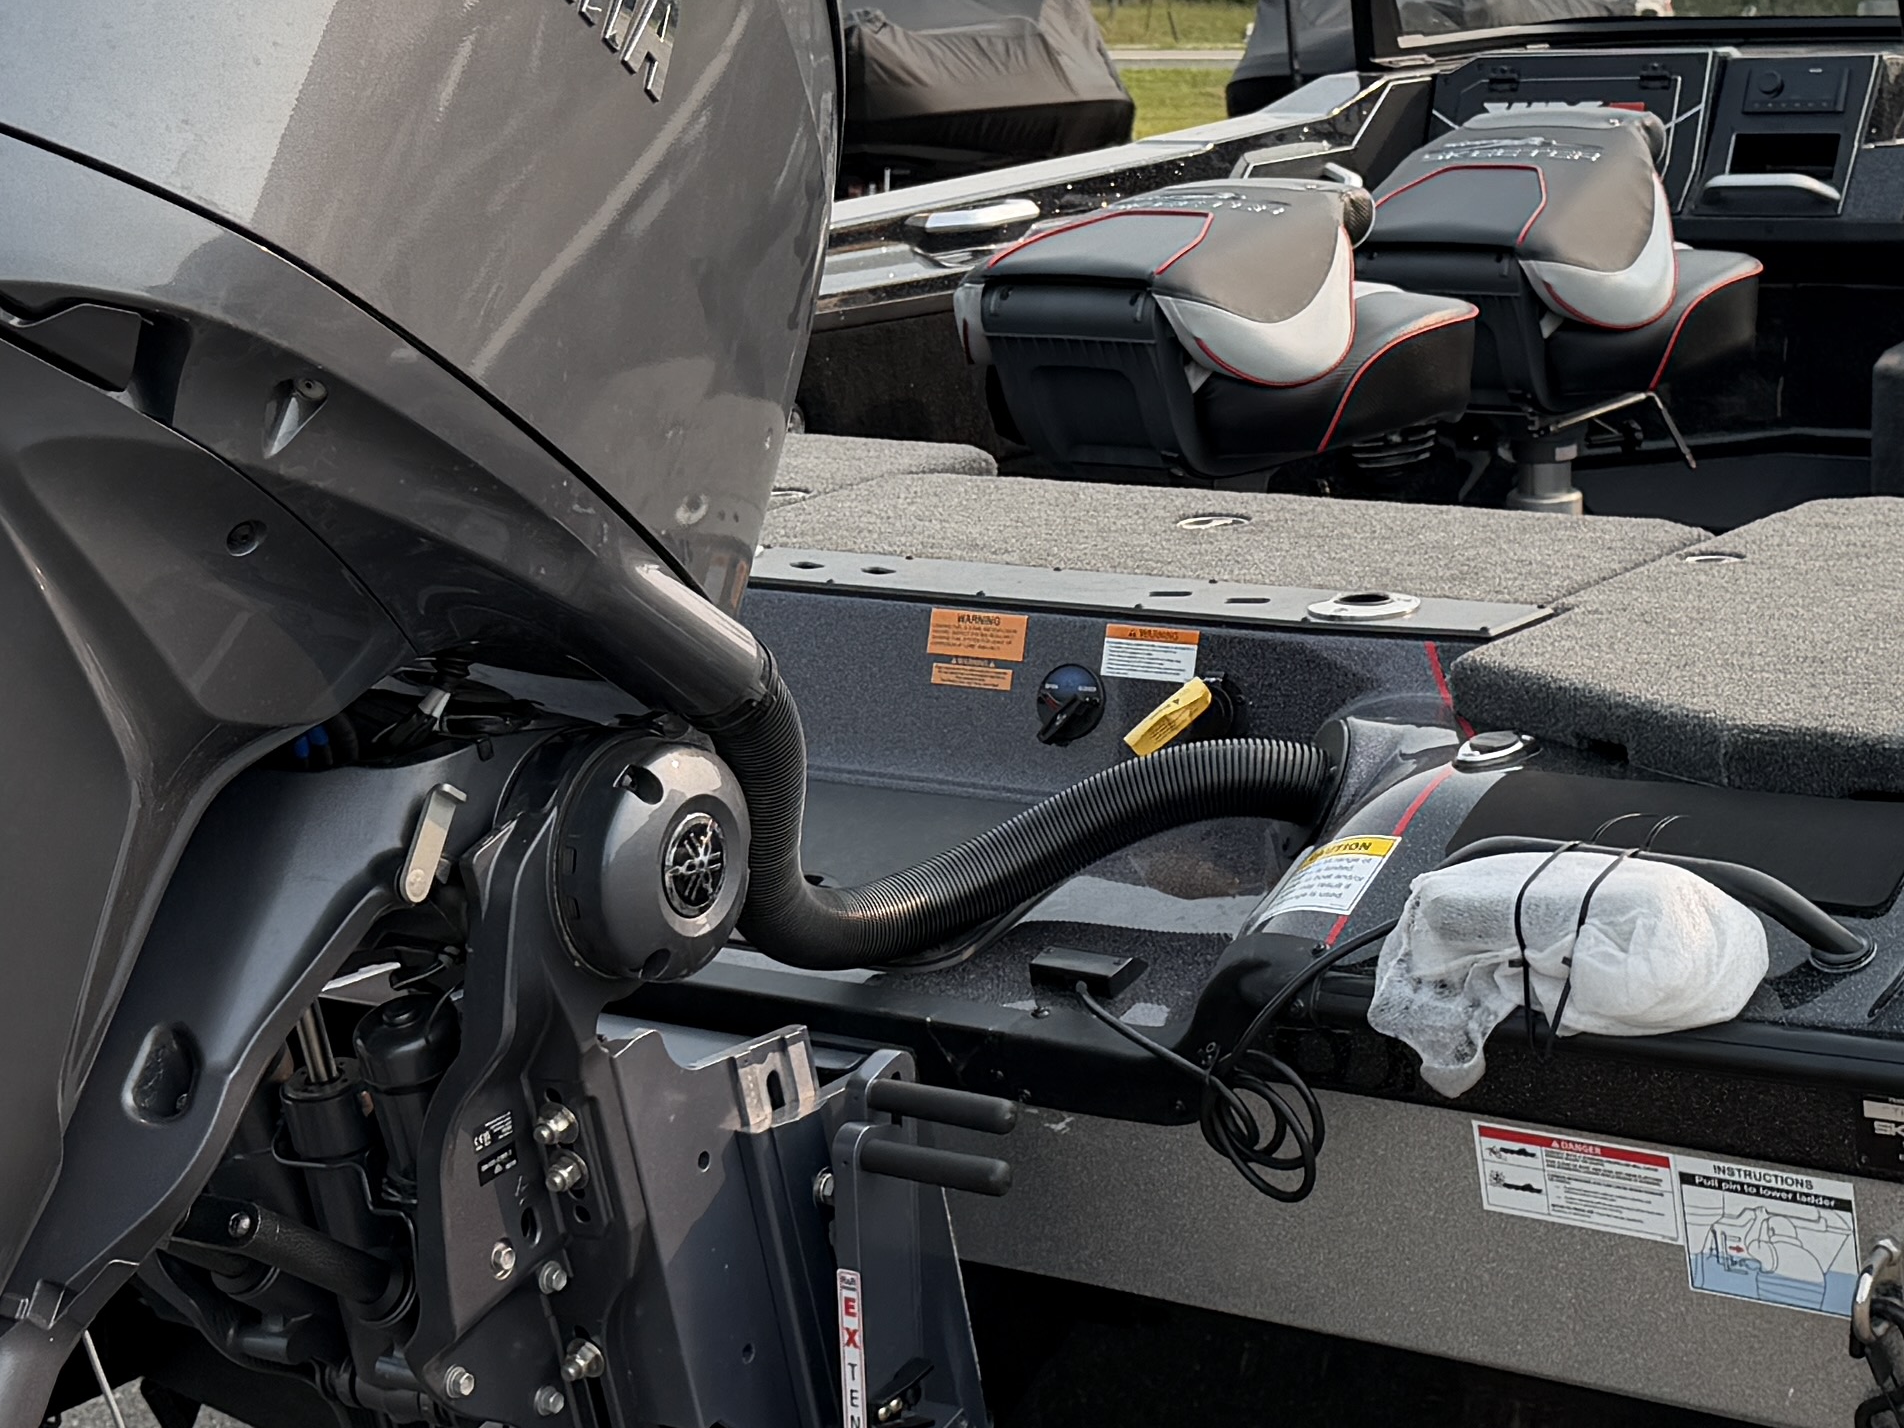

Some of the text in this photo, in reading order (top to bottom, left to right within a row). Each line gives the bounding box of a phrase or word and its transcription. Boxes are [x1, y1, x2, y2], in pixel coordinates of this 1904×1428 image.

[1559, 1140, 1602, 1156] DANGER
[1712, 1163, 1814, 1191] INSTRUCTIONS
[1695, 1175, 1836, 1208] Pull pin to lower ladder
